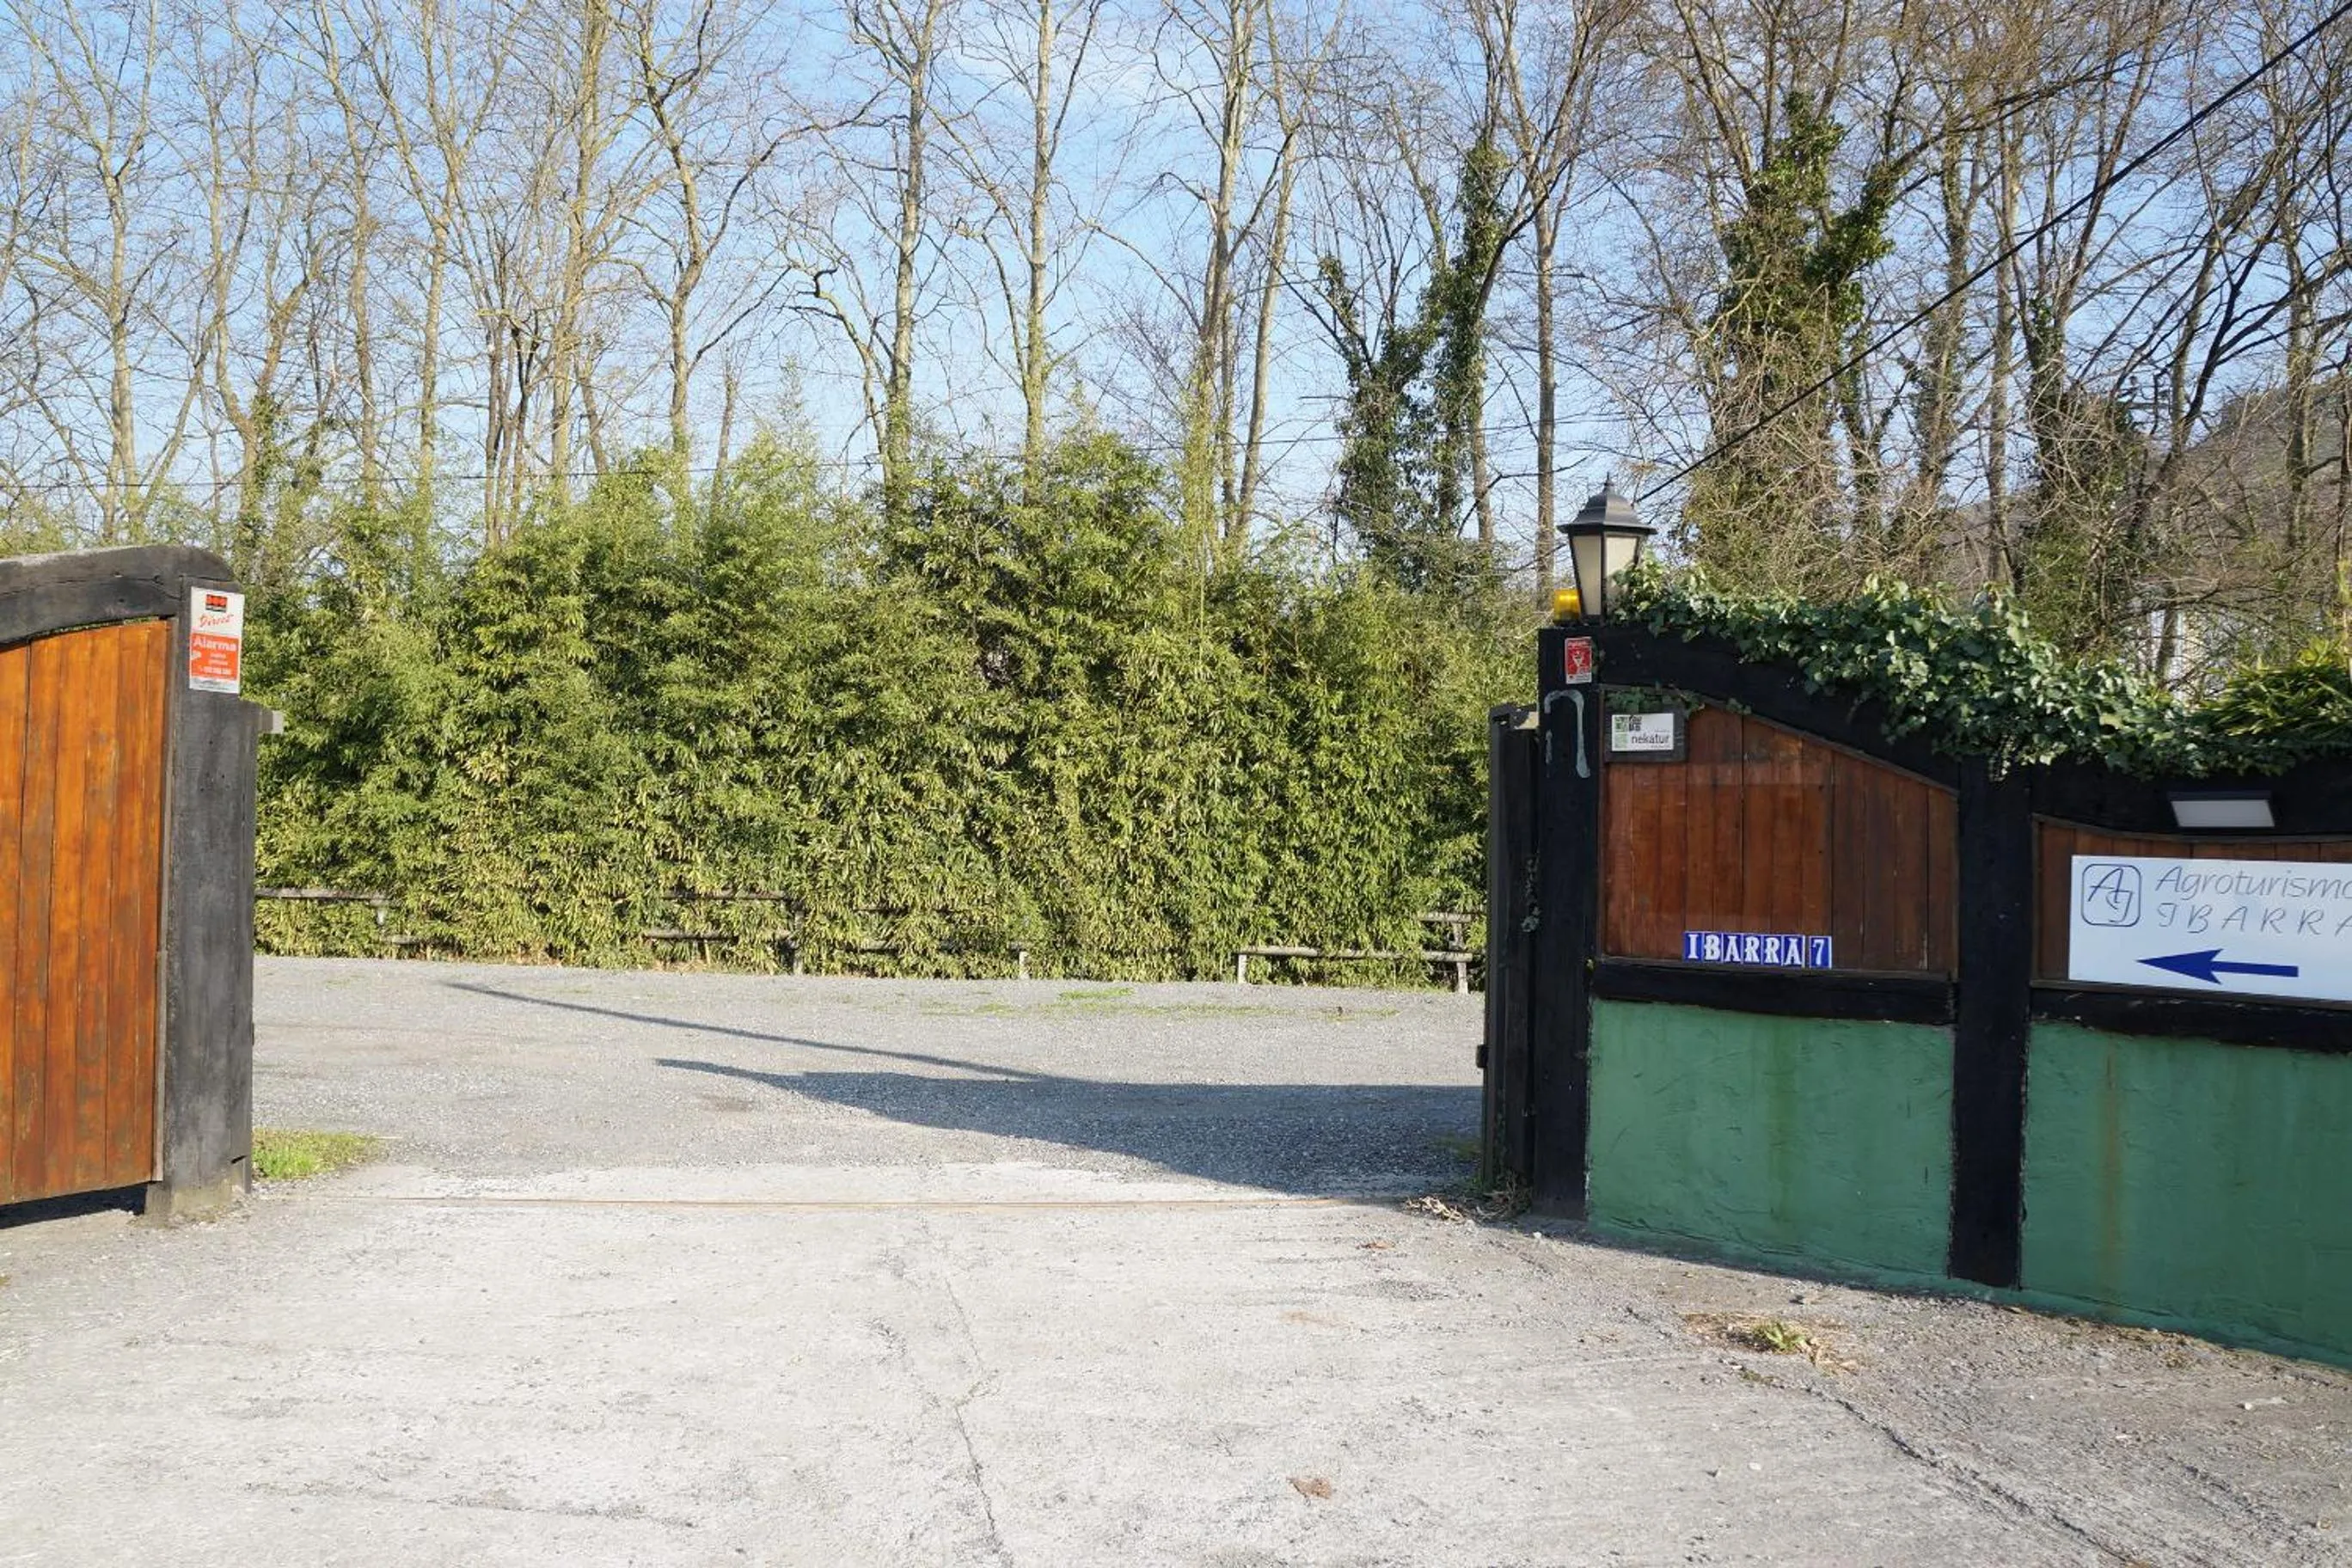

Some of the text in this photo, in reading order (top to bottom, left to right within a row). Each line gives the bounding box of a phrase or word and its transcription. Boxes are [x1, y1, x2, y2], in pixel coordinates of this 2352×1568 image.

[193, 635, 236, 652] Alarma
[1631, 733, 1670, 744] nekatur
[1687, 934, 1825, 966] IBARRA 7
